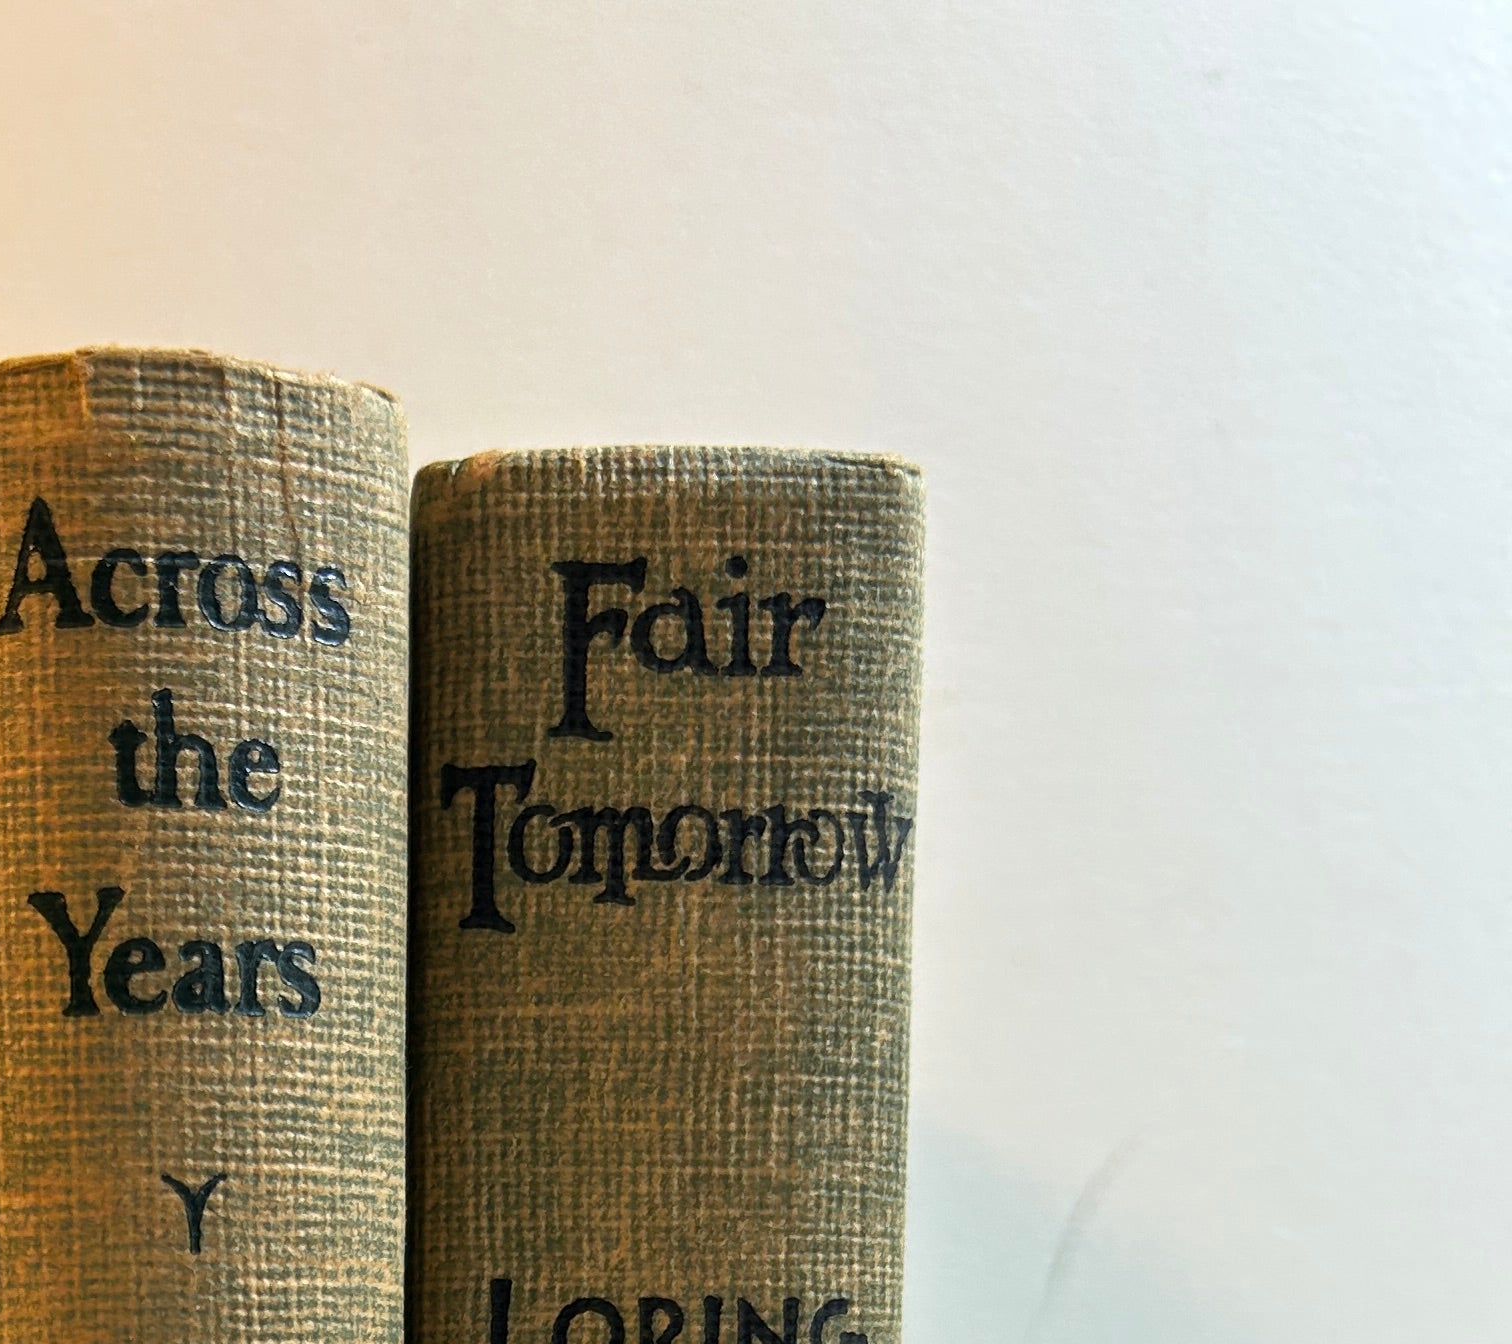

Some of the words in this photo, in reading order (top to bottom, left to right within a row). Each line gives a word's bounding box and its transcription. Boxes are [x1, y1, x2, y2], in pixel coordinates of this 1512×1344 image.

[548, 556, 826, 741] Fair
[109, 688, 282, 813] the
[441, 759, 913, 934] Tomorrow
[27, 886, 321, 1018] Years
